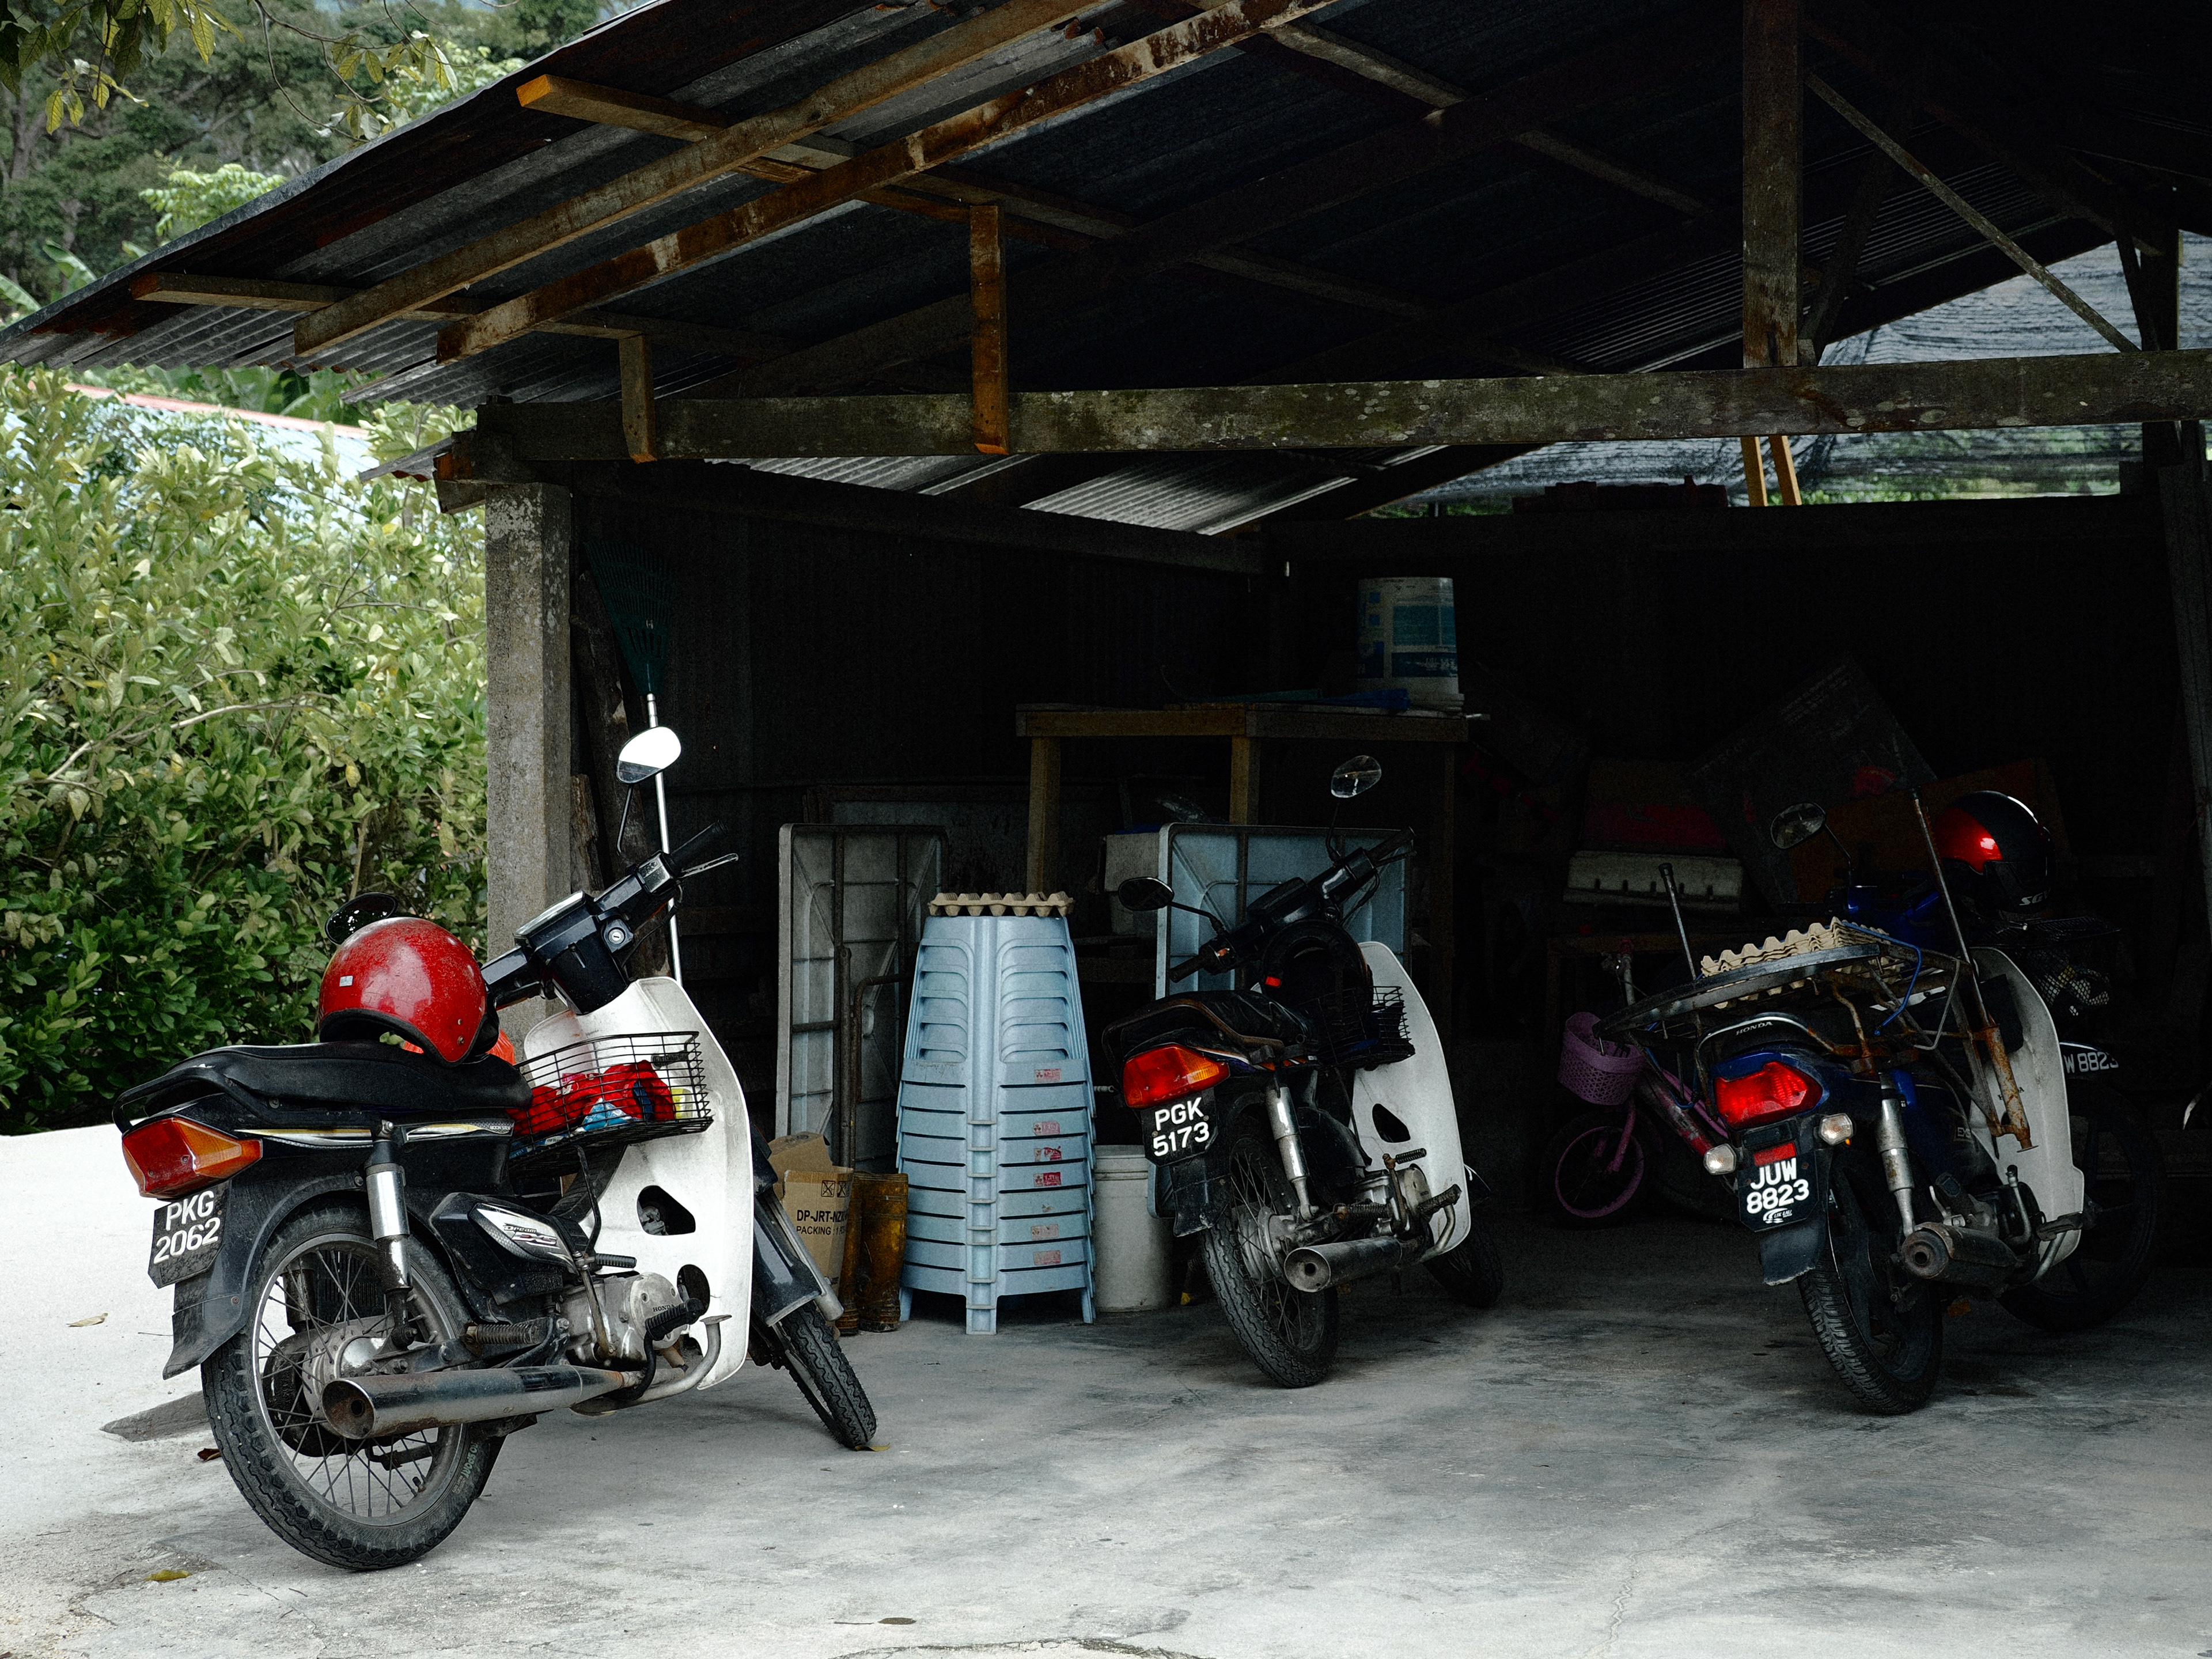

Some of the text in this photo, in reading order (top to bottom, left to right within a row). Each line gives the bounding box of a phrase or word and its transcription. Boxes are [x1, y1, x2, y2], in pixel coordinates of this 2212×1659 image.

[1735, 1021, 1774, 1036] HONDA
[1154, 1097, 1205, 1131] PGK
[1153, 1122, 1210, 1157] 5173
[1750, 1157, 1797, 1190] JUW
[165, 1190, 214, 1232] PKG
[1747, 1179, 1810, 1214] 8823
[153, 1217, 221, 1264] 2062
[503, 1224, 537, 1233] Dream
[797, 1226, 831, 1235] PACKING
[461, 1452, 477, 1479] SPORT
